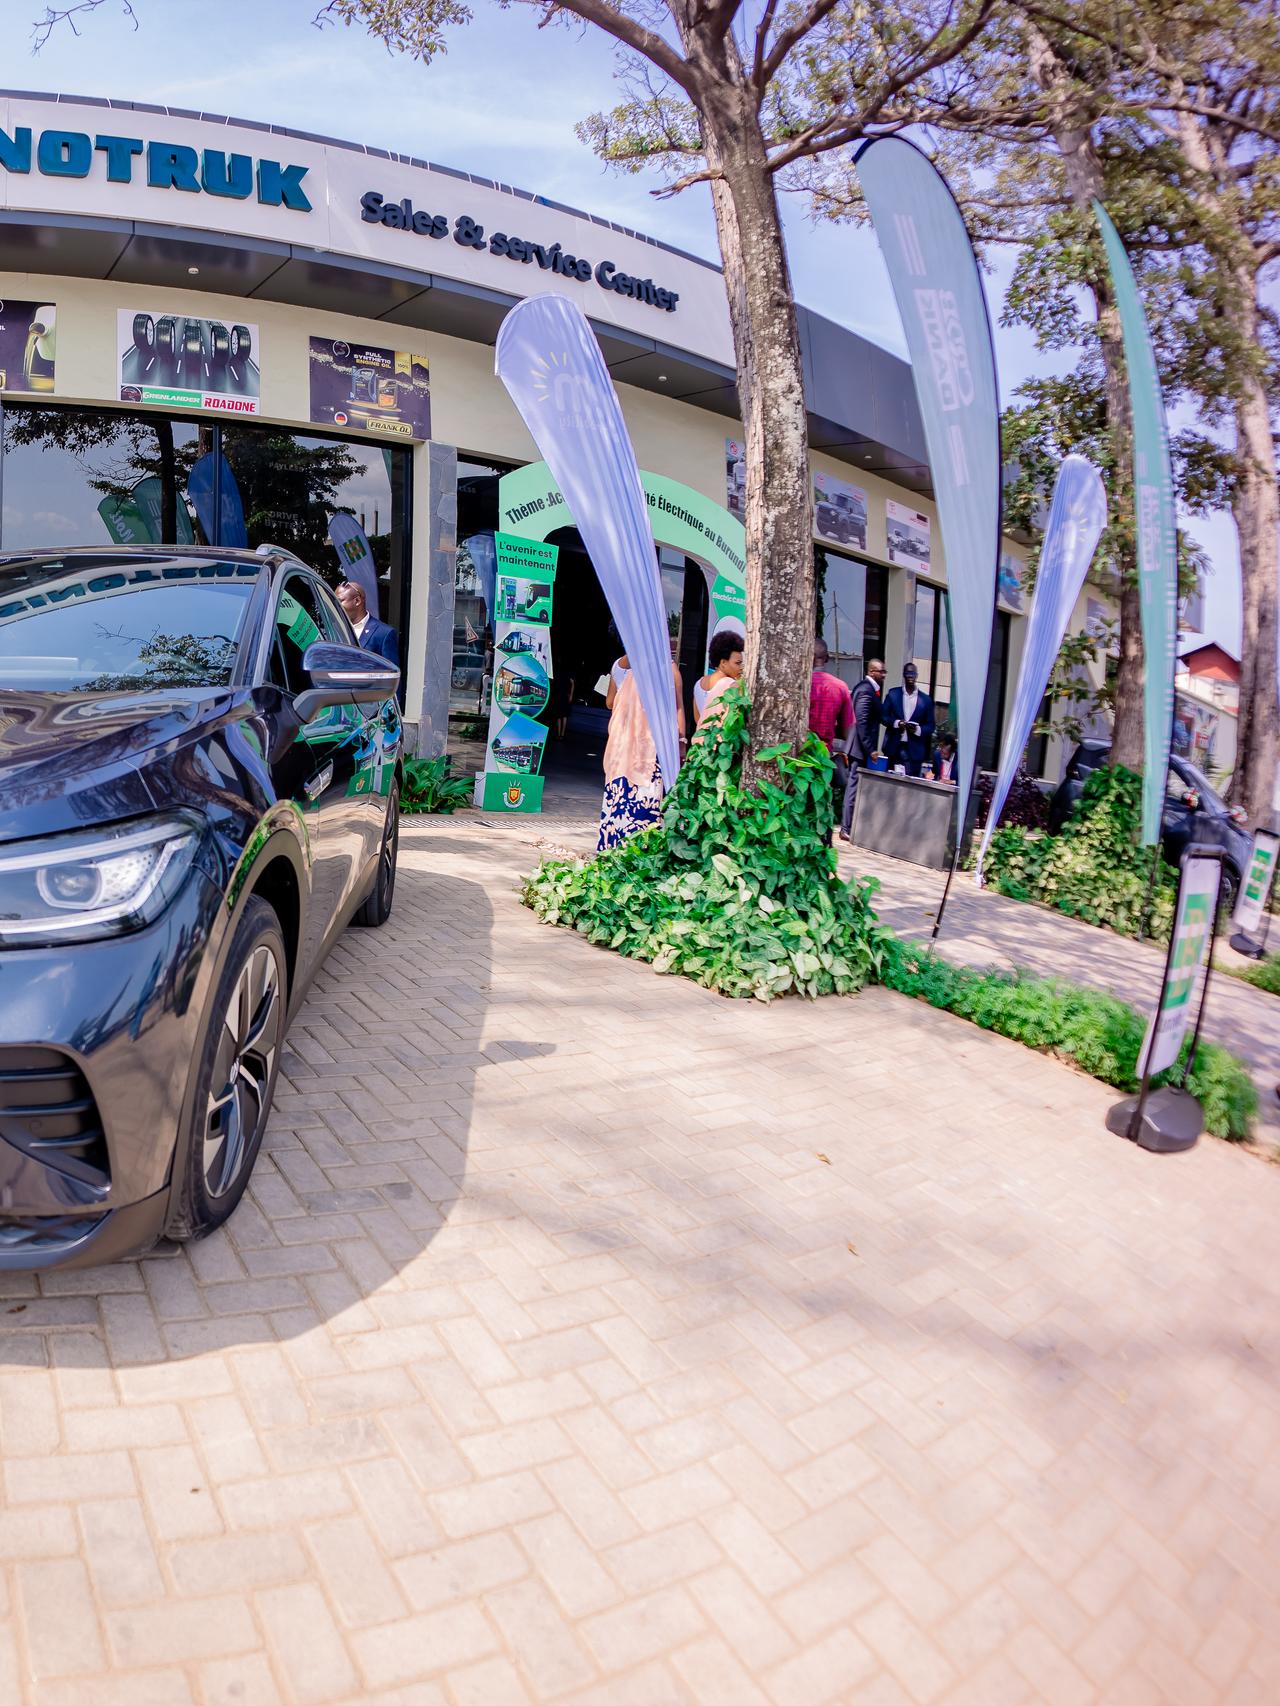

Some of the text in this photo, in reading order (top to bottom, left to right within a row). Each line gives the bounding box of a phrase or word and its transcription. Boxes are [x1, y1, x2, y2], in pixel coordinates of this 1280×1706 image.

[360, 191, 680, 313] Sales & service Center
[353, 354, 391, 365] SYNTHETIC
[204, 397, 256, 412] ROADONE
[369, 421, 410, 435] FRANK ÖL
[505, 498, 545, 525] Thème
[657, 493, 704, 532] Électrique
[704, 526, 716, 542] au
[716, 535, 746, 574] Burundi
[499, 541, 553, 559] L'avenir est
[499, 554, 556, 571] maintenant
